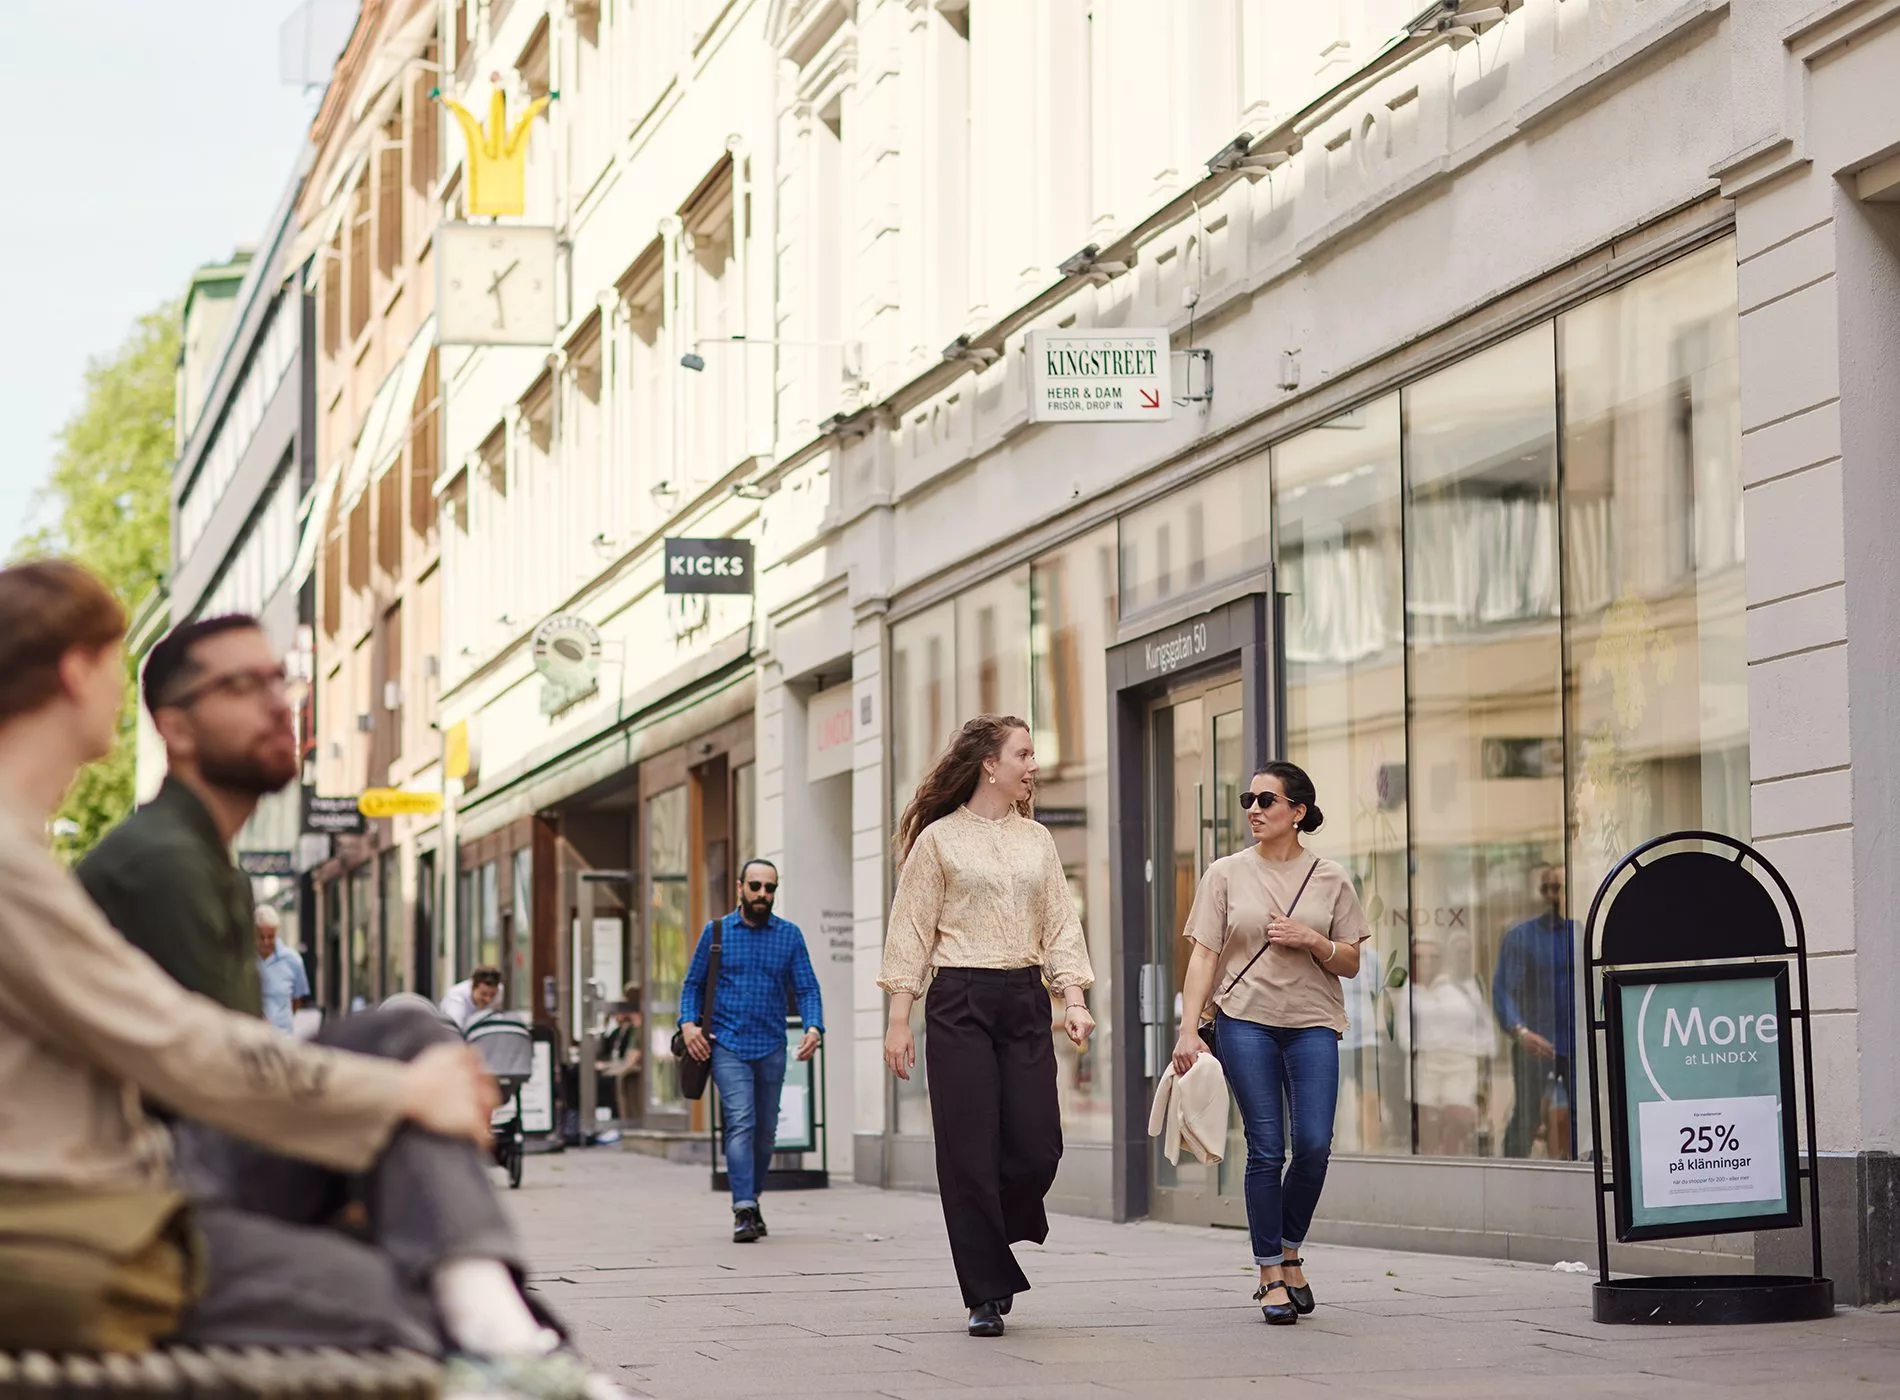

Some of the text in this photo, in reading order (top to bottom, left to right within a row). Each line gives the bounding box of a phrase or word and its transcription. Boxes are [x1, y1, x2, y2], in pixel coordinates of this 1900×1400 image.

[1046, 341, 1156, 350] SALONG
[1046, 350, 1157, 376] KINGSTREET
[1047, 387, 1122, 399] HERR & DAM
[1086, 401, 1111, 410] DROP
[1114, 401, 1123, 410] IN
[670, 555, 744, 576] KICKS
[1145, 623, 1207, 672] Kungsgatan 50
[1383, 907, 1465, 928] INDEX
[1663, 1007, 1779, 1047] More
[1685, 1051, 1758, 1065] at LINDEX
[1680, 1124, 1740, 1154] 25%
[1669, 1157, 1752, 1174] på klänningar
